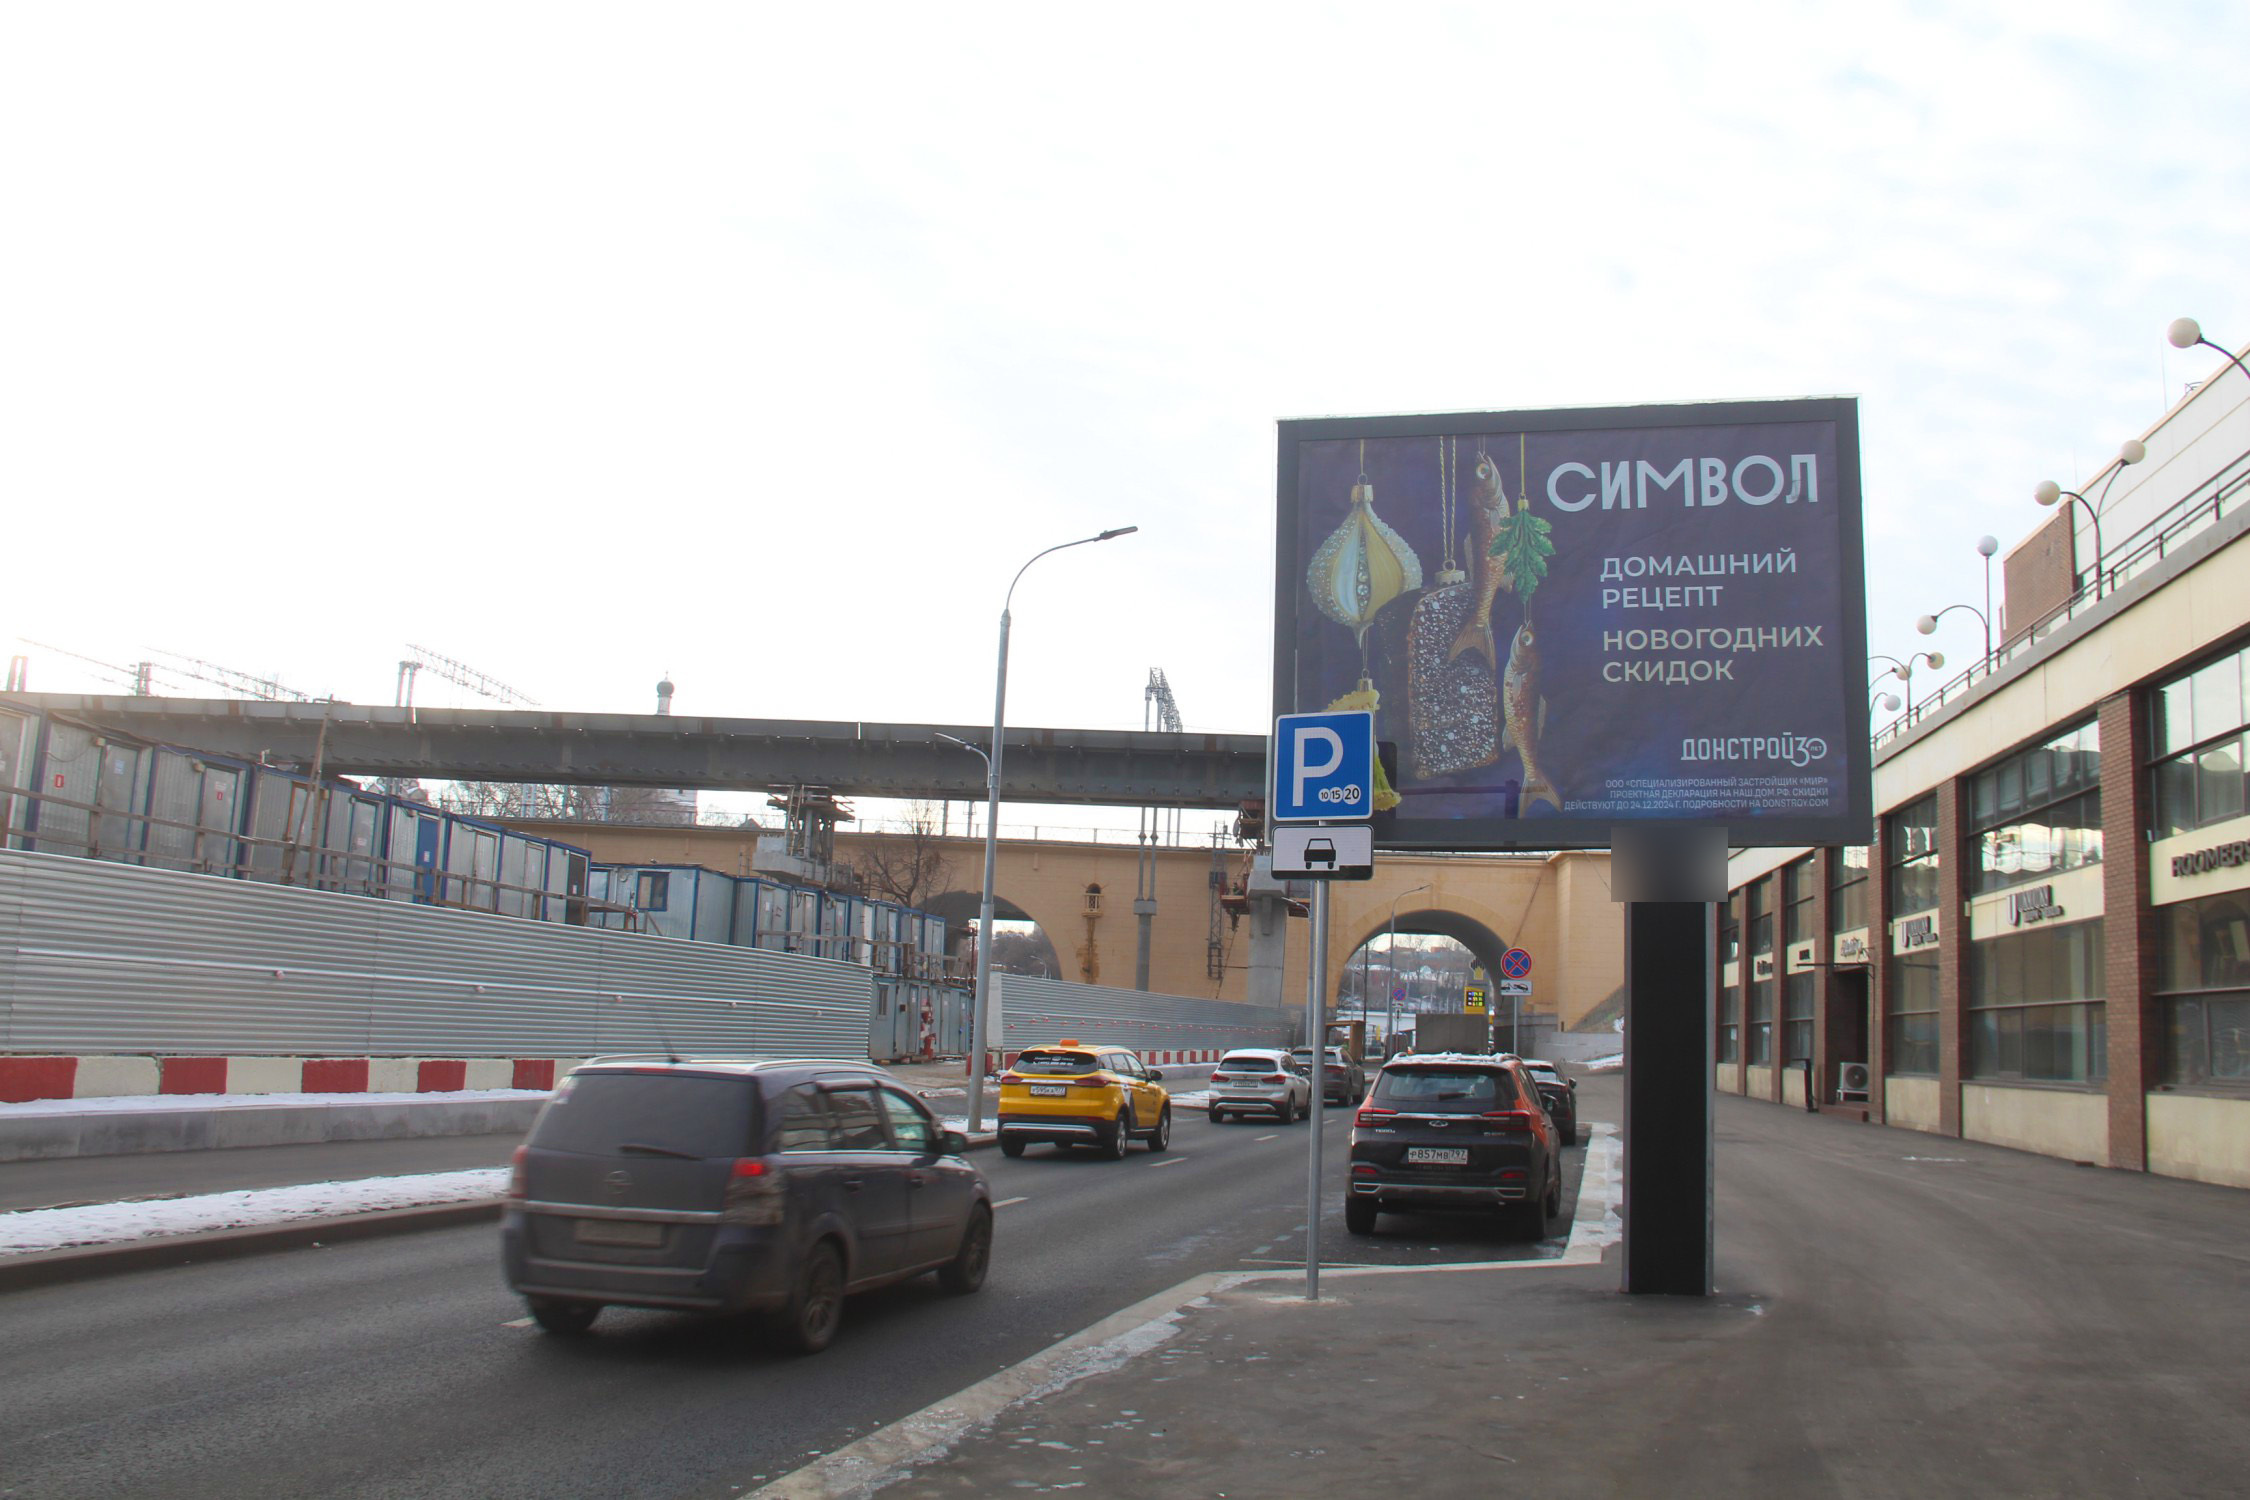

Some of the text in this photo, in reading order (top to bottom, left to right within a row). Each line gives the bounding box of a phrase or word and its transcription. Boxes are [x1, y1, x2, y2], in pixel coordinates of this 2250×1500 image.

[1546, 453, 1819, 513] СИМВОЛ
[1599, 547, 1797, 583] ДОМАШНИЙ
[1602, 585, 1724, 612] РЕЦЕПТ
[1602, 625, 1824, 653] НОВОГОДНИХ
[1602, 659, 1735, 686] СКИДОК
[1680, 731, 1794, 761] ДОНСТРОЙ
[1292, 726, 1344, 807] P
[1320, 788, 1360, 800] 10 15 20
[1605, 779, 1625, 789] ООО
[1738, 775, 1798, 788] ЗАСТРОЙЩИК
[1610, 789, 1660, 799] ПРОЕКТНАЯ
[1662, 788, 1719, 800] ДЕКЛАРАЦИЯ
[1720, 788, 1732, 798] НА
[1792, 787, 1829, 797] СКИДКИ
[1564, 799, 1616, 811] ДЕЙСТВУЮТ
[1616, 800, 1629, 811] ДО
[1630, 800, 1674, 809] 24.12.2024
[1683, 799, 1747, 810] ПОДРОБНОСТИ
[1749, 799, 1761, 808] НА
[1762, 798, 1829, 808] DONSTROY.COM
